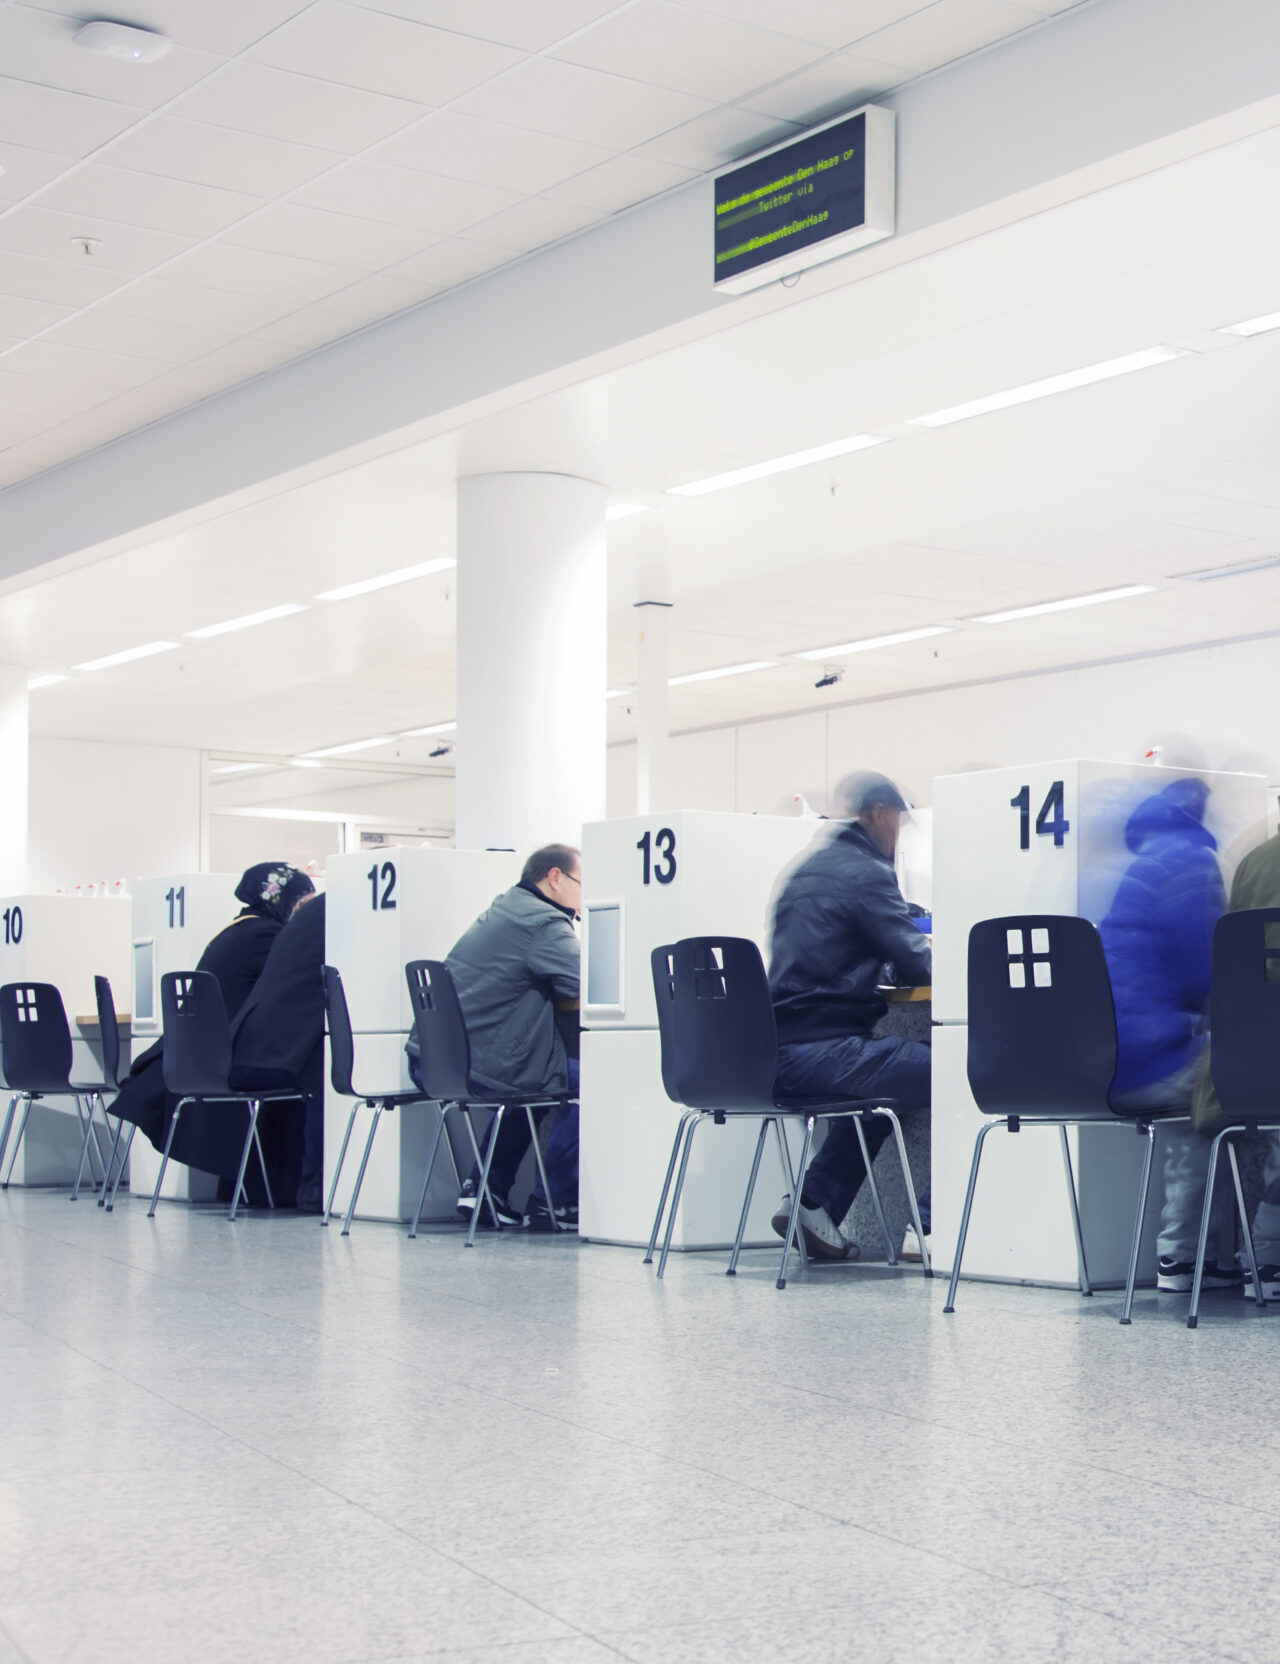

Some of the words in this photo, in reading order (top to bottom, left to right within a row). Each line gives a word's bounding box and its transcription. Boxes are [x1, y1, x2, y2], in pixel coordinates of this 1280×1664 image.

[797, 168, 814, 182] Den
[817, 156, 839, 173] Haag
[759, 192, 793, 214] Twitter
[797, 183, 814, 197] via
[1010, 781, 1070, 849] 14
[636, 828, 677, 884] 13
[367, 862, 397, 910] 12
[3, 906, 23, 944] 10
[165, 887, 185, 928] 11
